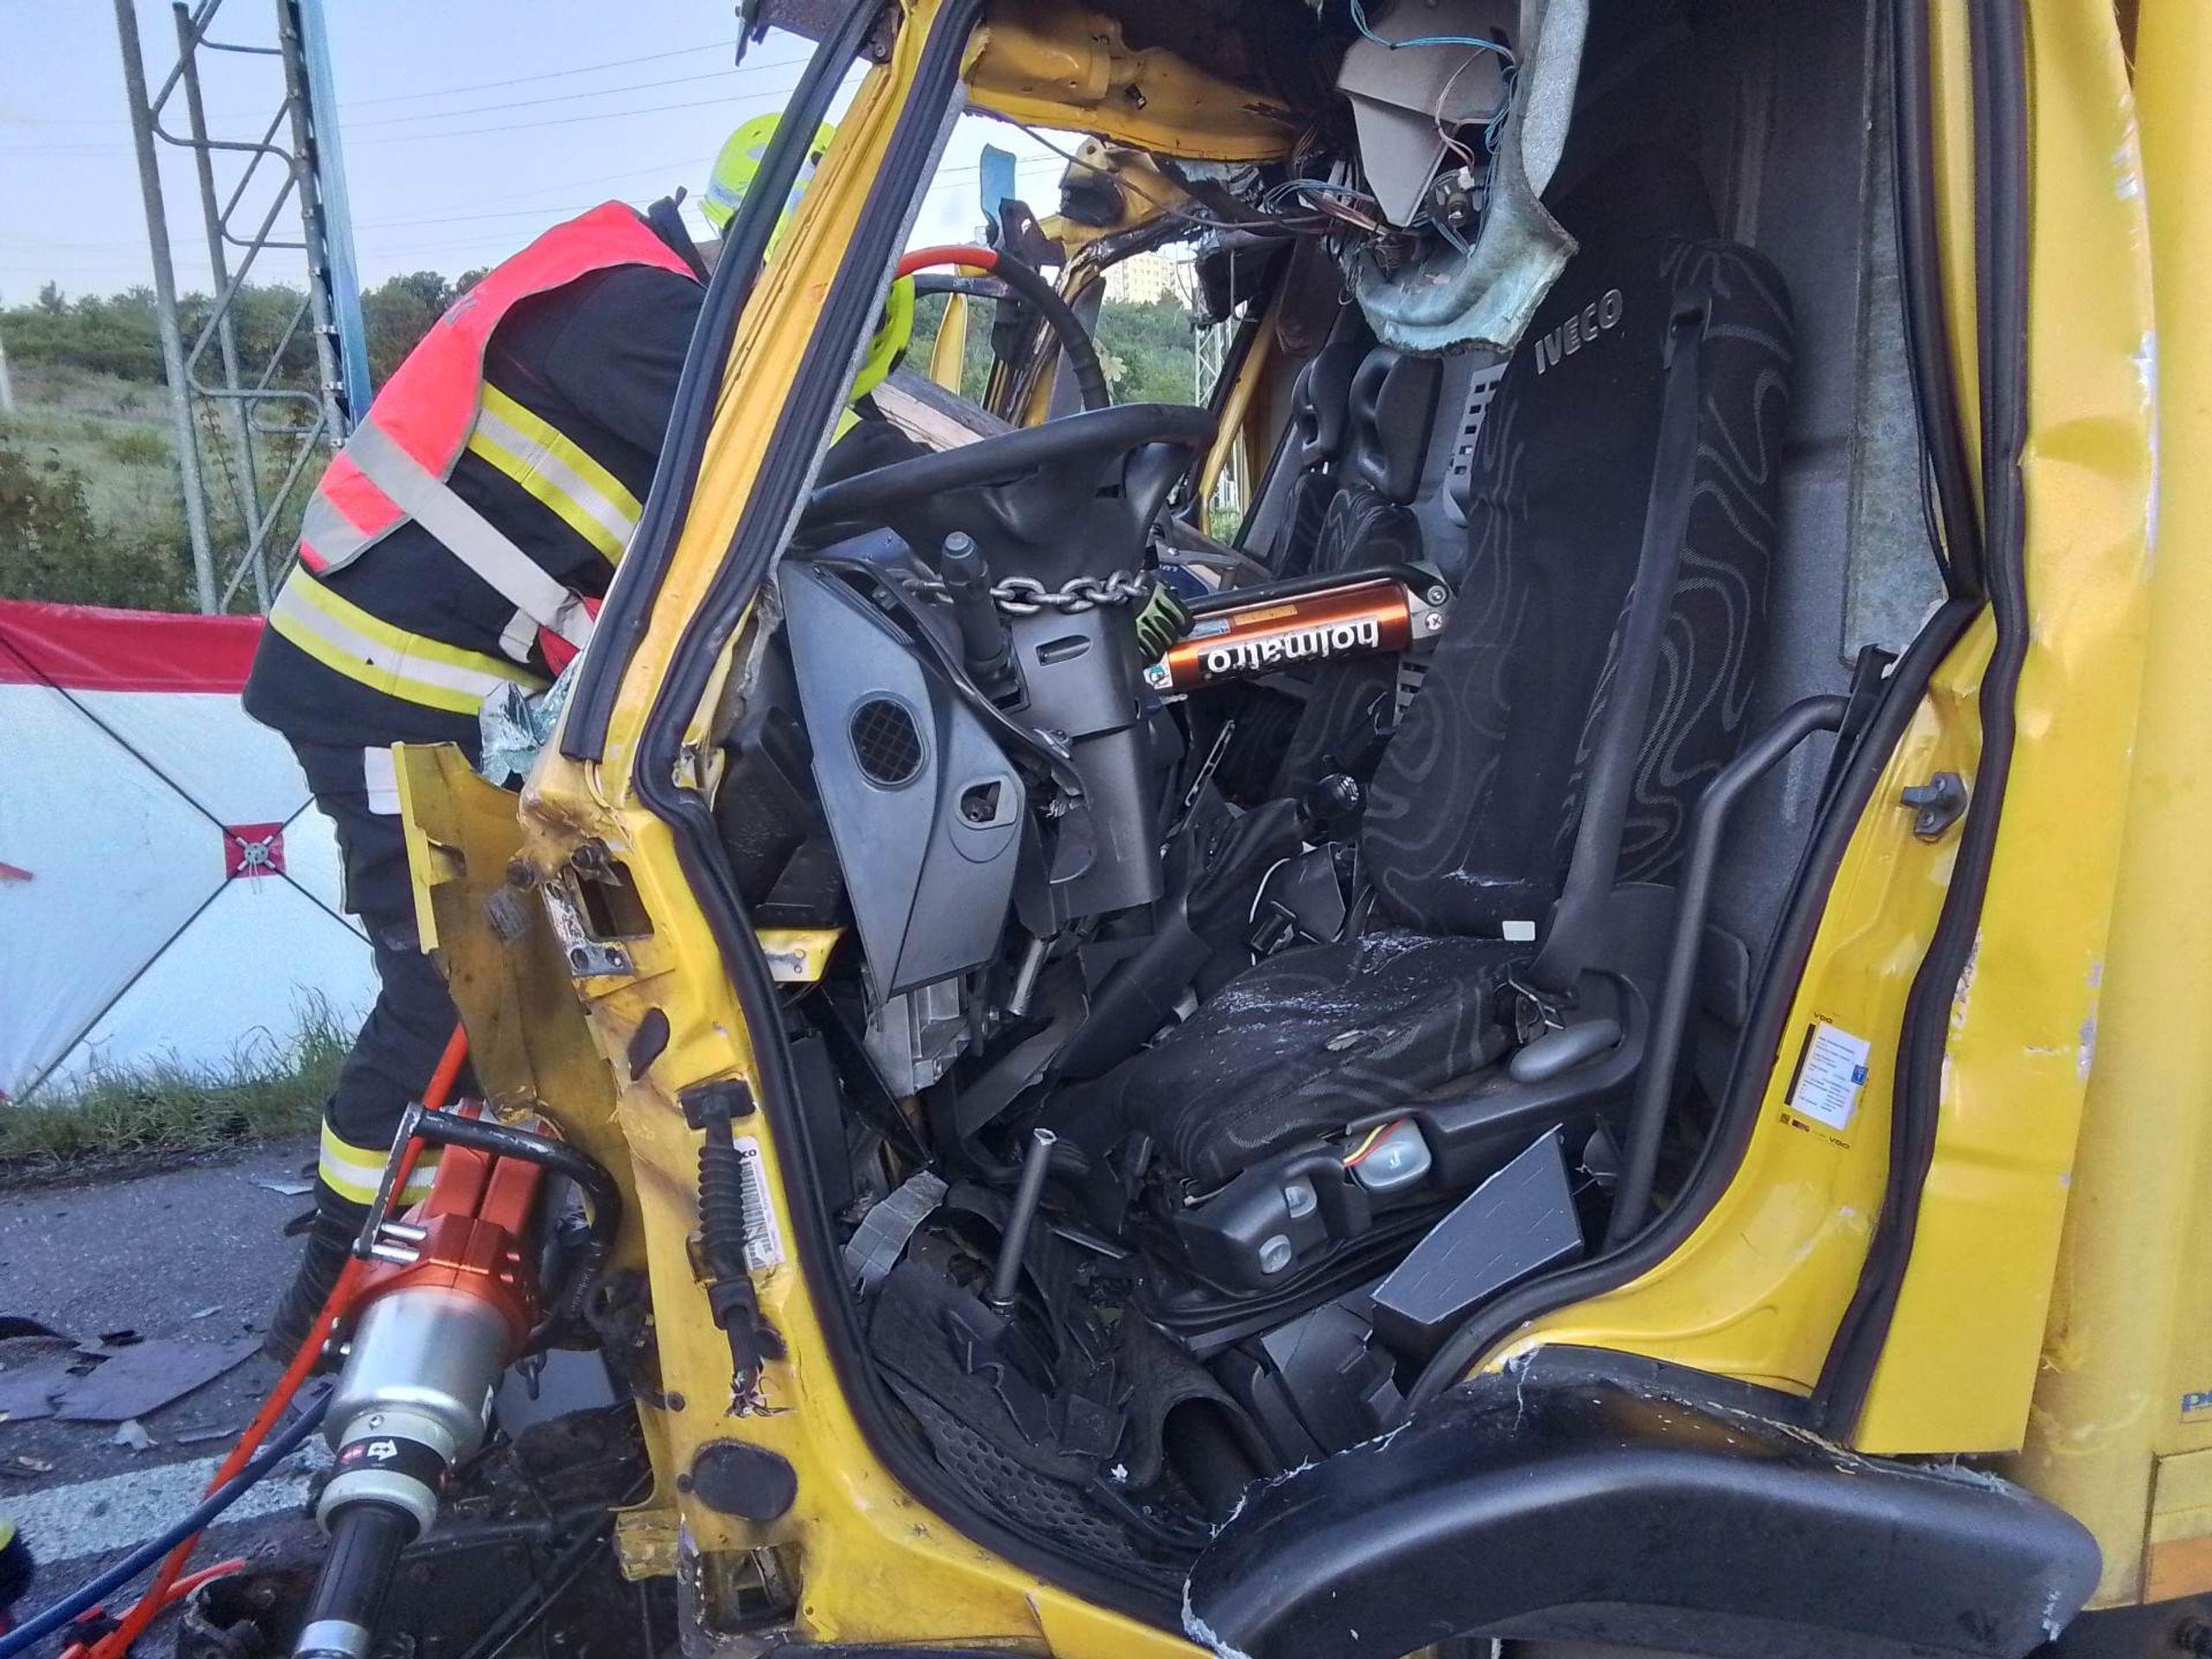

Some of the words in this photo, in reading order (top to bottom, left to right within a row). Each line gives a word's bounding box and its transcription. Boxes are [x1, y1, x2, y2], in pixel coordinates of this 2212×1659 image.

[1535, 289, 1623, 375] IVECO
[1207, 619, 1379, 673] holmatro
[1829, 1136, 1851, 1149] VDO
